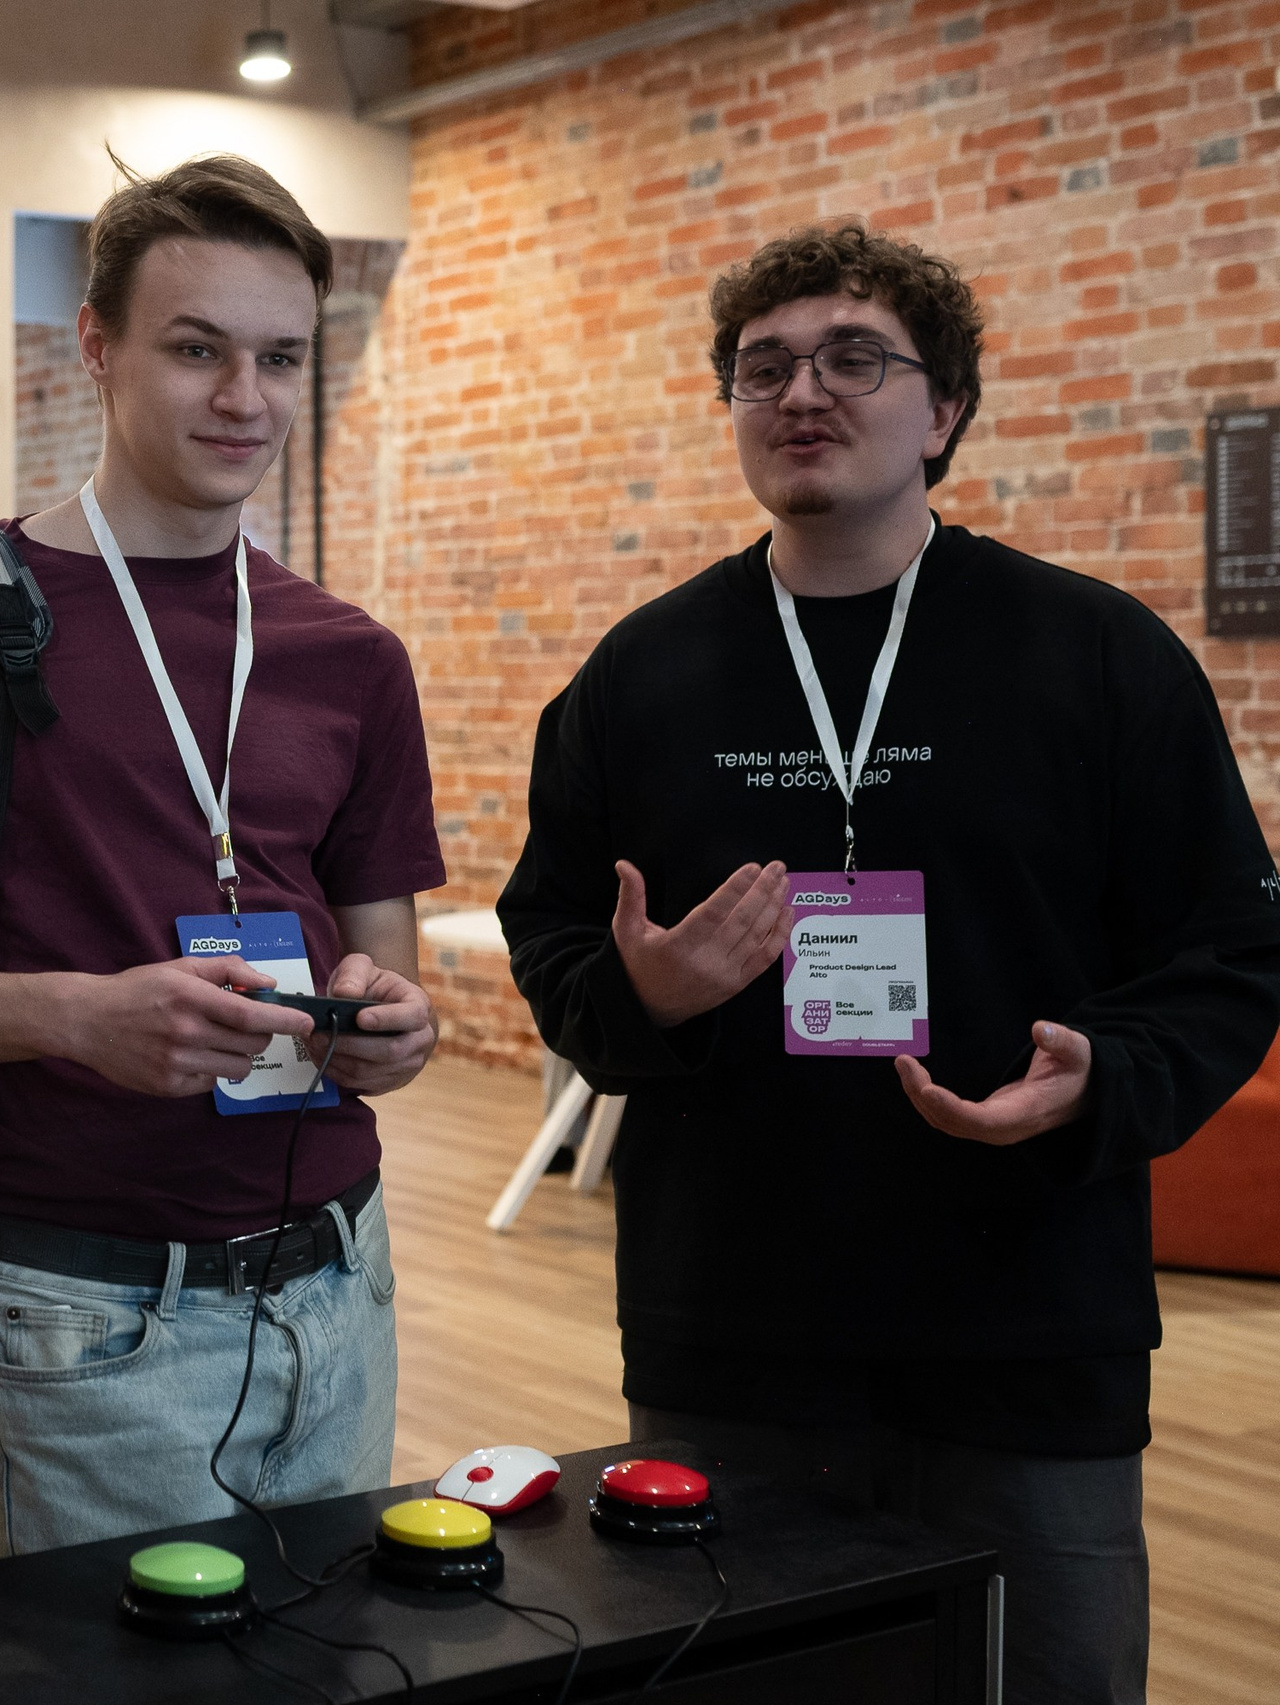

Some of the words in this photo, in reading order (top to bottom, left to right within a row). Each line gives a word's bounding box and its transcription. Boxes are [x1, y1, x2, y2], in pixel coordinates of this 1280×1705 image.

[714, 752, 772, 767] темы
[779, 749, 869, 766] мен
[873, 746, 932, 764] ляма
[747, 772, 774, 787] не
[795, 894, 849, 904] AGDays
[798, 932, 858, 946] Даниил
[192, 939, 240, 952] AGDays
[798, 948, 831, 957] Ильин
[845, 964, 875, 972] Design
[835, 1001, 855, 1009] Все
[808, 1025, 826, 1033] ОР
[251, 1062, 284, 1071] секции
